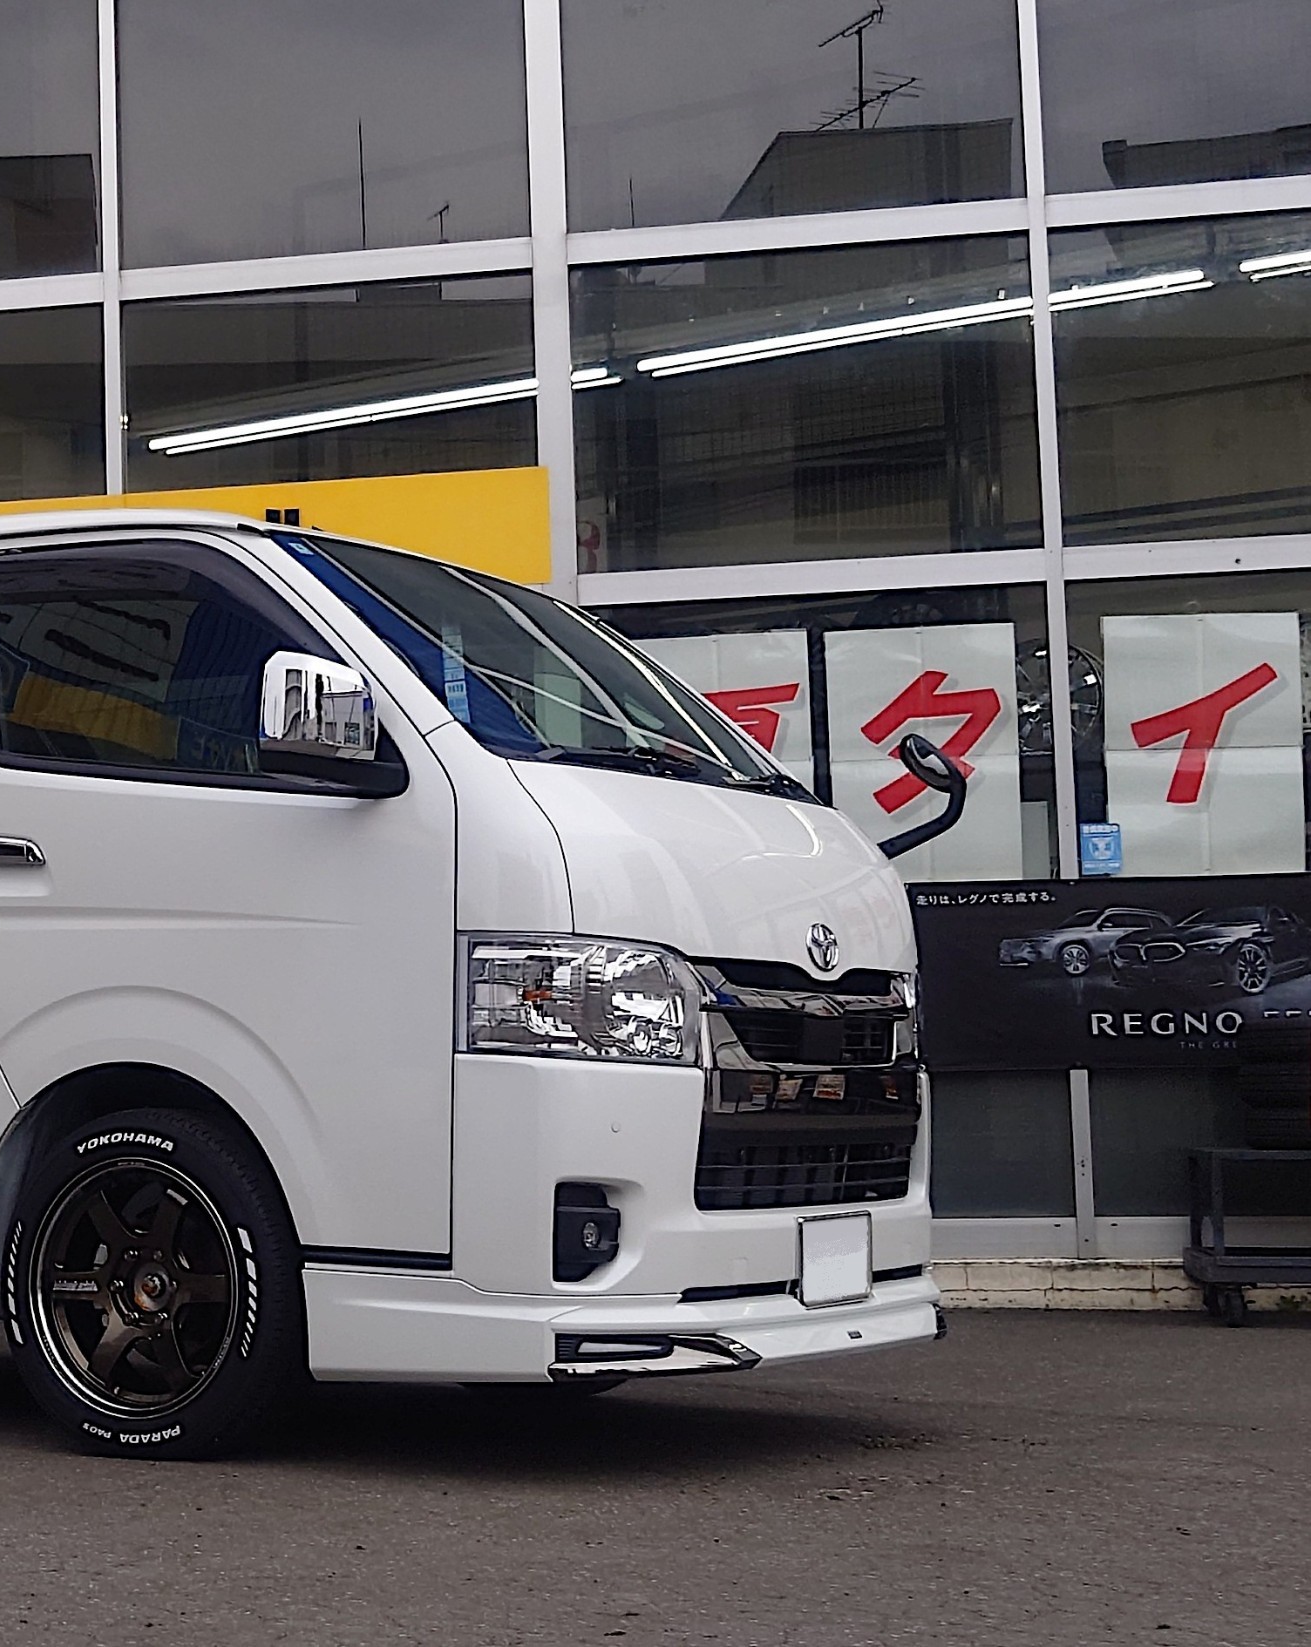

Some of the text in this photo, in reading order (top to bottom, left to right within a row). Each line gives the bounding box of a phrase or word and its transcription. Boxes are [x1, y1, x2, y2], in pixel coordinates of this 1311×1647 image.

[1091, 1011, 1243, 1036] REGNO
[76, 1132, 174, 1154] YOKOHAMA
[119, 1425, 181, 1444] PARADA
